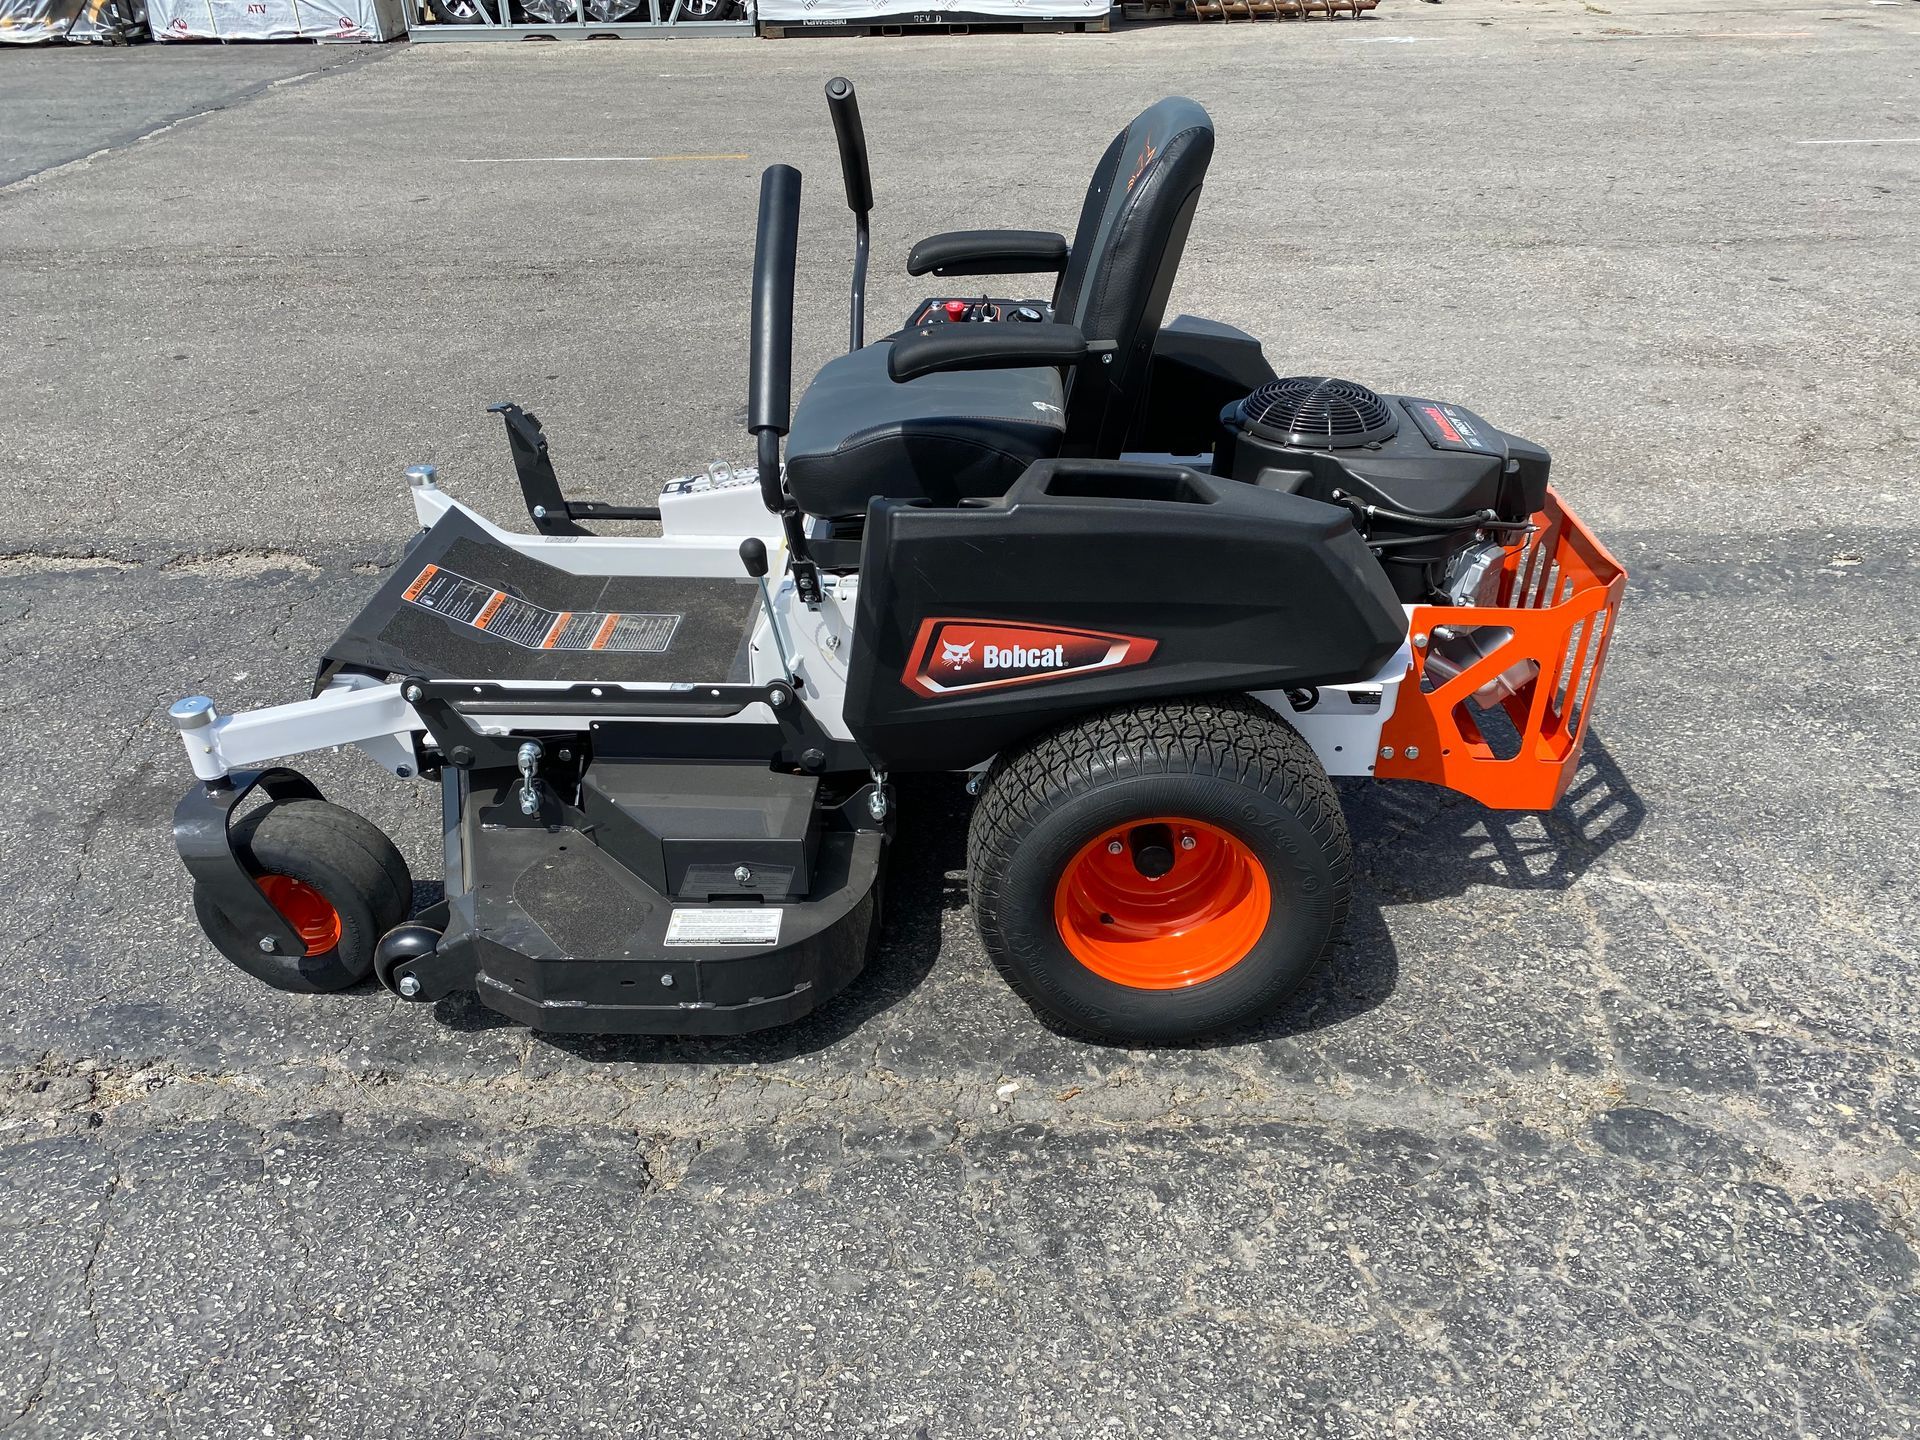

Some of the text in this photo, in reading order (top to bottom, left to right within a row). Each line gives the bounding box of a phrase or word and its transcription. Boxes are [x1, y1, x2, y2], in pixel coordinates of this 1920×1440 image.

[247, 4, 266, 14] ATV
[913, 14, 942, 23] REV D
[413, 570, 433, 592] WARNING
[983, 644, 1064, 669] Bobcat
